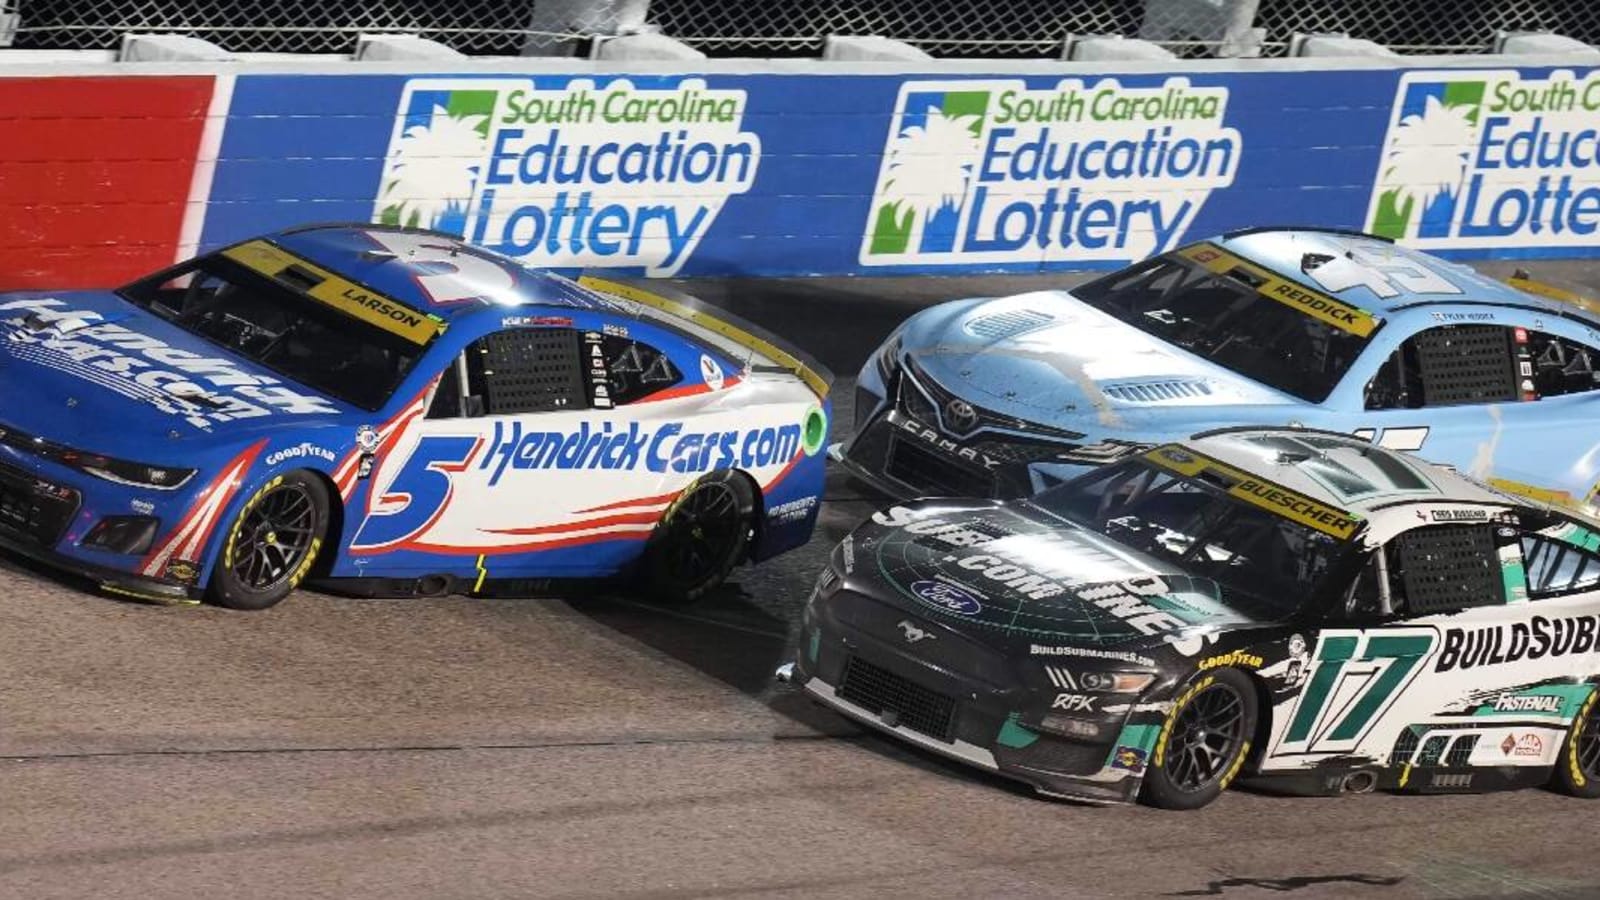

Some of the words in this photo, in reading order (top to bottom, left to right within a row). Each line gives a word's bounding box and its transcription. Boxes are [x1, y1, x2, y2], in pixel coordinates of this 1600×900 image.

[501, 89, 596, 124] South
[603, 89, 737, 124] Carolina
[993, 89, 1084, 124] South
[1090, 88, 1218, 121] Carolina
[1490, 81, 1576, 112] South
[486, 128, 752, 185] Education
[978, 126, 1235, 183] Education
[1474, 116, 1600, 169] Educ
[471, 189, 709, 269] Lottery
[962, 186, 1192, 260] Lottery
[342, 287, 423, 328] LARSON
[1273, 284, 1360, 325] REDDICK
[265, 442, 336, 465] GOODYEAR
[352, 434, 483, 553] 5
[1239, 479, 1353, 531] BUESCHER
[919, 582, 971, 609] Ford
[940, 554, 1066, 606] .COM
[1199, 649, 1264, 671] GOODYEAR
[1435, 615, 1600, 674] BUILDSUB
[1051, 693, 1098, 712] RFK
[1279, 630, 1438, 751] 17
[1495, 692, 1560, 713] FASTENAL
